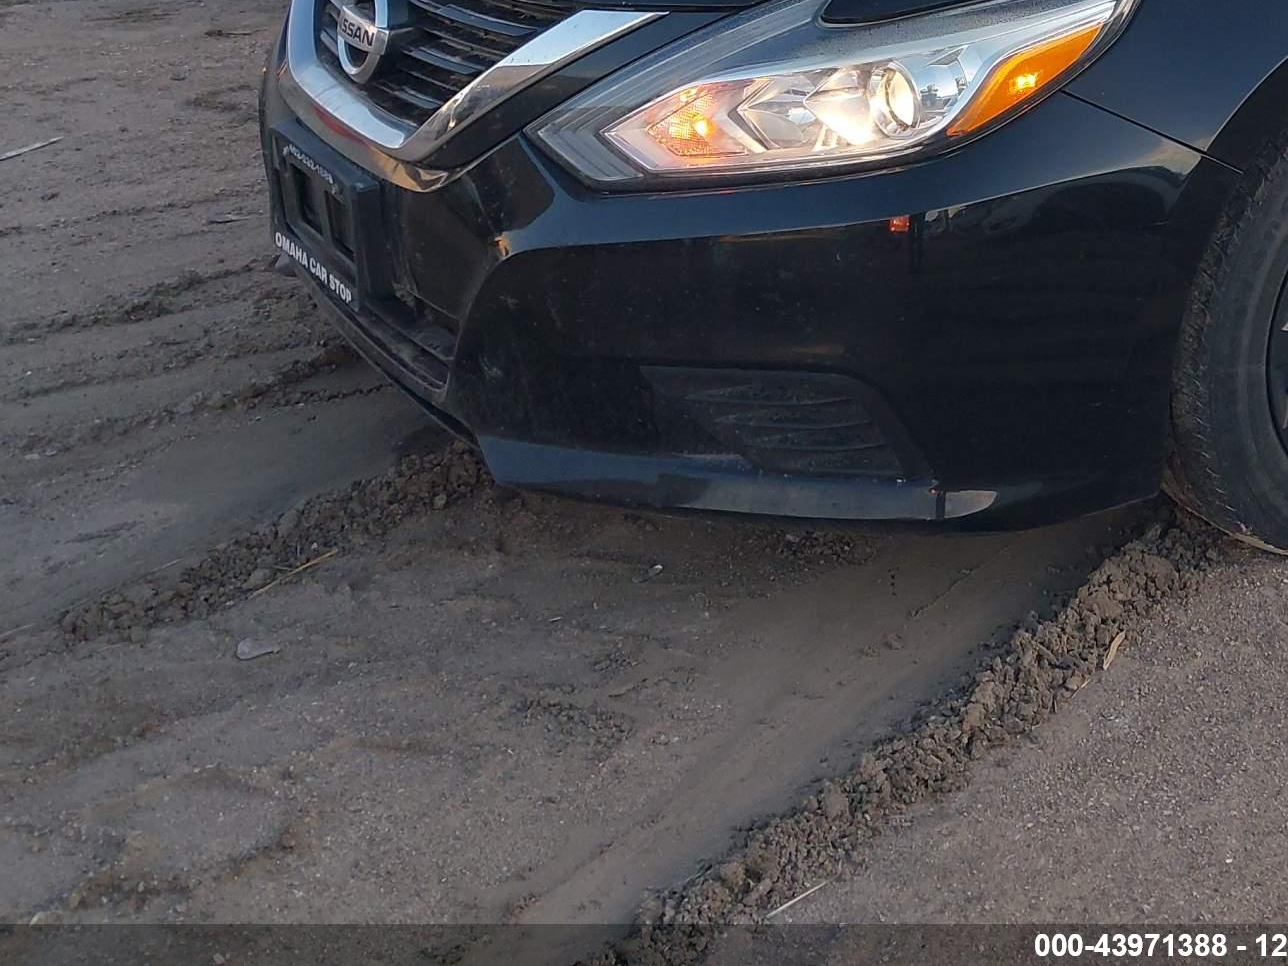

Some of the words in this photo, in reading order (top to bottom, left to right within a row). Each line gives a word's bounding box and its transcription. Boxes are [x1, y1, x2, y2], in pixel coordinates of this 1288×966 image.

[341, 17, 376, 47] SSAN
[275, 231, 308, 269] OMAHA
[309, 257, 328, 285] CAR
[329, 275, 352, 304] STOP
